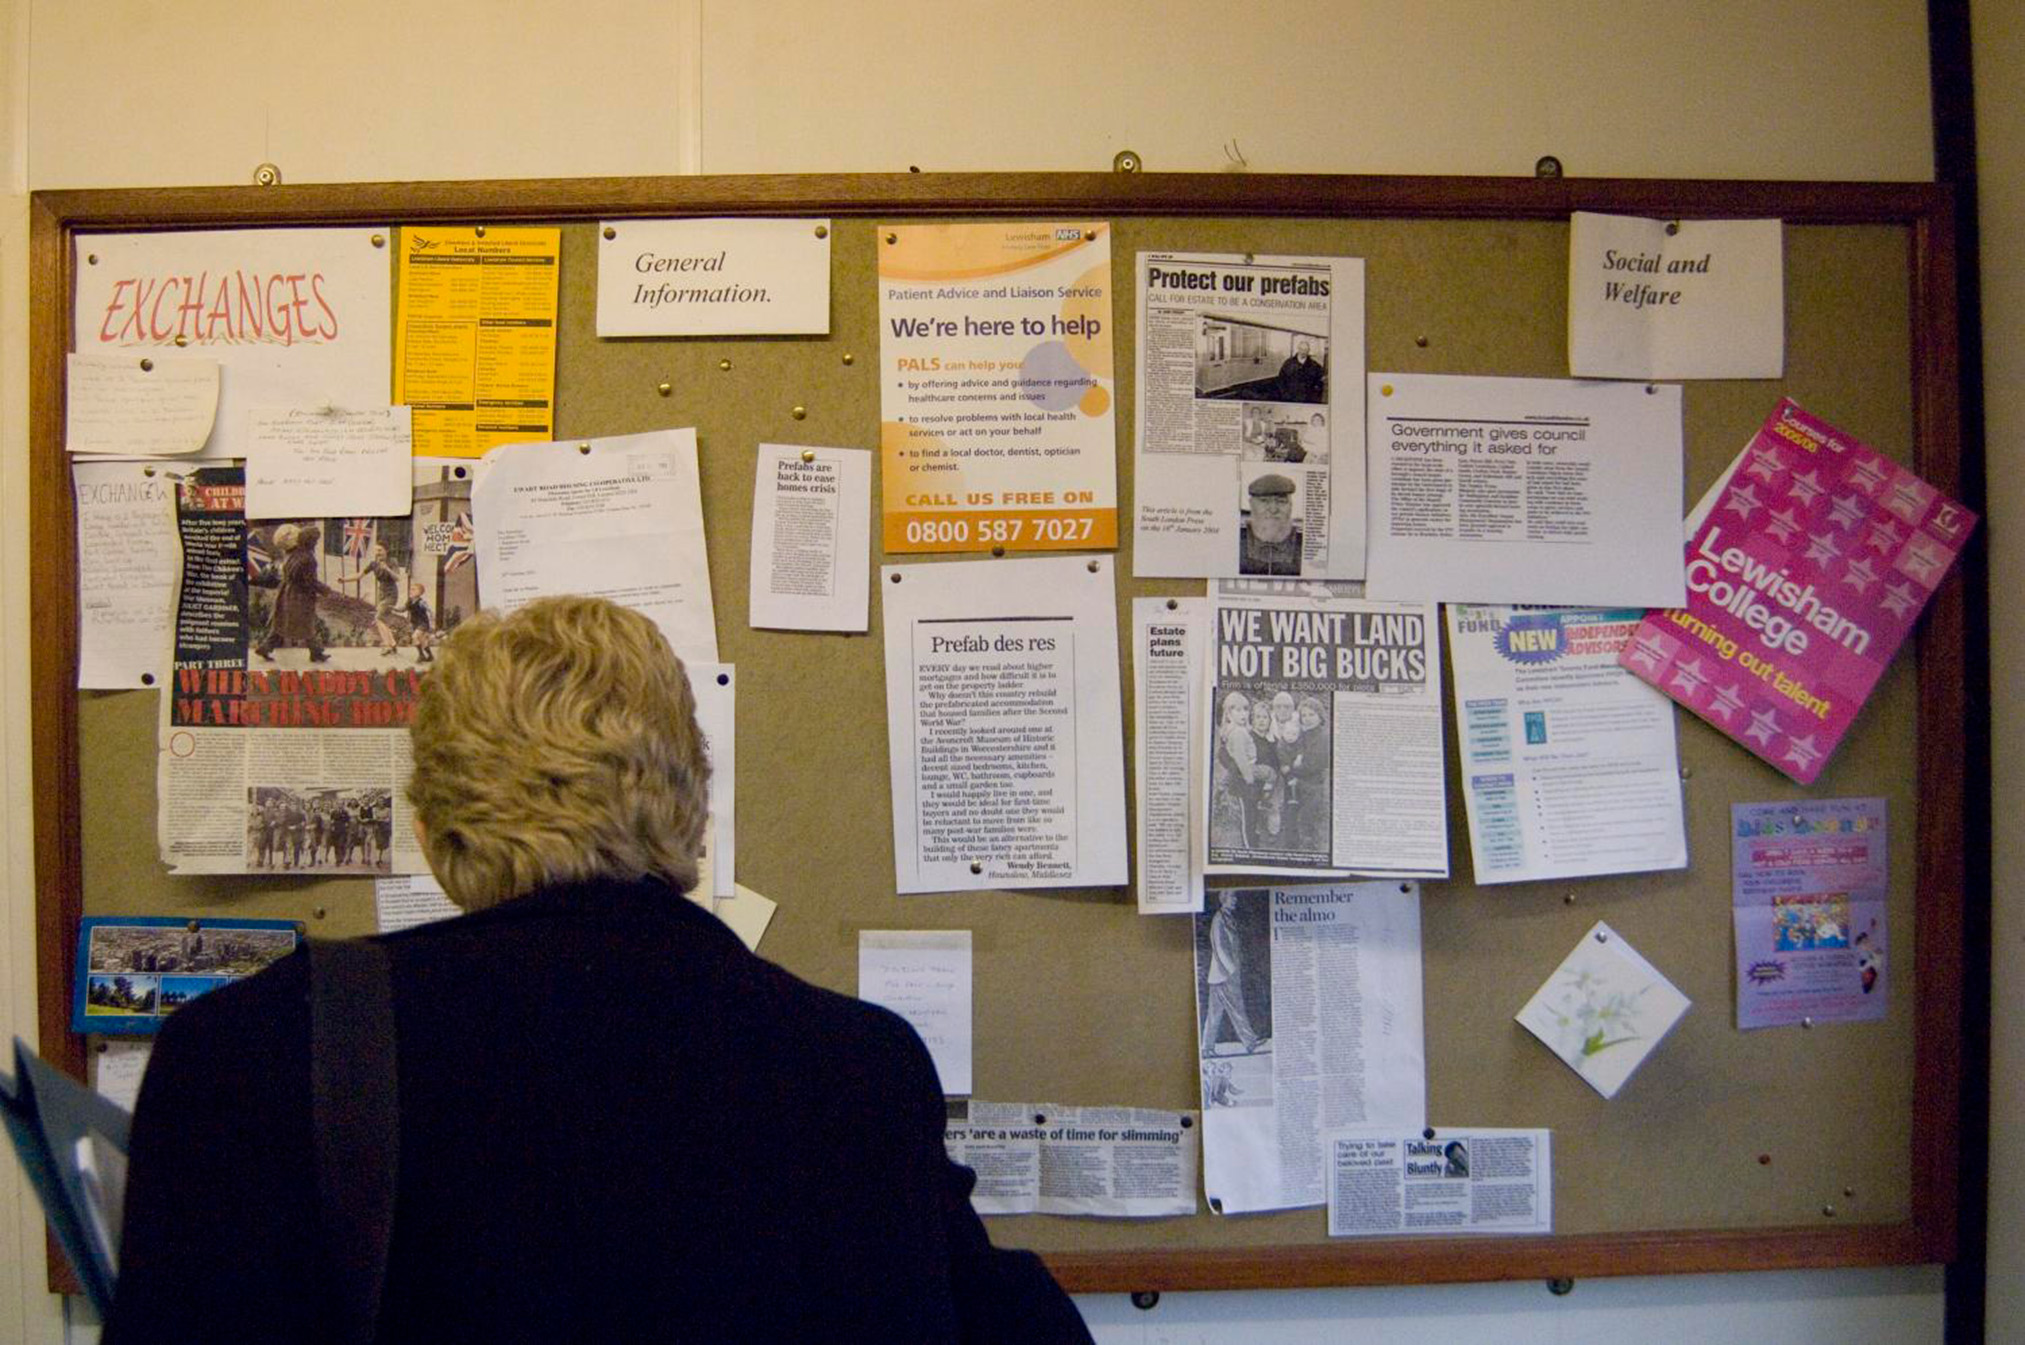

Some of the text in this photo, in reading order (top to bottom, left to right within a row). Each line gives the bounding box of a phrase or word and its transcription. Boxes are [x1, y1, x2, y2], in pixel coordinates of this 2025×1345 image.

[1005, 230, 1080, 241] Lewisham NHS
[635, 251, 726, 273] General
[1603, 249, 1711, 274] Social and
[1148, 267, 1329, 296] Protect our prefabs
[633, 283, 771, 309] Information.
[889, 287, 1102, 300] Patient Advice and Liaison Service
[1605, 282, 1682, 309] Welfare
[101, 271, 338, 342] EXCHANGES
[1148, 293, 1327, 310] CALL FOR ESTATE TO BE A CONSERVATION AREA
[892, 314, 1101, 339] We're here to help
[897, 358, 940, 371] PALS
[945, 362, 965, 371] can
[969, 359, 995, 372] help
[908, 377, 1097, 390] by offering advice and guidance regarding
[909, 394, 955, 402] healthcare
[909, 415, 918, 423] to
[956, 414, 998, 423] problems
[1001, 413, 1021, 421] with
[1024, 413, 1044, 421] local
[1047, 412, 1076, 420] health
[909, 429, 944, 437] services
[989, 429, 1009, 437] your
[1013, 427, 1042, 435] behalf
[1391, 423, 1586, 442] Government gives council
[922, 449, 939, 457] find
[951, 449, 971, 457] local
[974, 448, 1005, 457] doctor,
[1008, 448, 1042, 457] dentist,
[1045, 448, 1080, 456] optician
[1391, 440, 1557, 455] everything it asked for
[778, 461, 832, 472] Prefabs are
[922, 463, 959, 471] chemist.
[777, 471, 835, 483] back to ease
[205, 488, 245, 497] CHILD
[777, 482, 836, 494] homes crisis
[906, 491, 1093, 506] CALL US FREE ON
[423, 524, 454, 534] WELCO
[907, 518, 1093, 543] 0800 587 7027
[1698, 525, 1872, 656] Lewisham
[1685, 559, 1809, 656] College
[1150, 626, 1186, 636] Estate
[1221, 609, 1423, 646] WE WANT LAND
[1458, 620, 1500, 633] FUND
[931, 635, 1055, 653] Prefab des res
[1150, 638, 1181, 648] plans
[1509, 623, 1641, 653] NEW INDEPENDE
[1150, 648, 1184, 658] future
[174, 658, 245, 670] PART THREE
[919, 664, 950, 673] EVERY
[952, 664, 966, 673] day
[1003, 663, 1025, 671] about
[1027, 662, 1053, 672] higher
[1221, 645, 1425, 681] NOT BIG BUCKS
[1222, 680, 1241, 689] Firm
[1738, 652, 1773, 682] out
[1773, 671, 1832, 720] talent
[1274, 890, 1353, 905] Remember
[1274, 908, 1335, 922] the almo
[970, 1128, 996, 1140] 'are
[999, 1131, 1006, 1140] a
[1010, 1130, 1047, 1140] waste
[1050, 1129, 1064, 1140] of
[1066, 1130, 1096, 1142] time
[1099, 1129, 1118, 1142] for
[1122, 1129, 1184, 1144] slimming'
[1407, 1143, 1442, 1157] Talking
[1407, 1161, 1442, 1177] Bluntly
